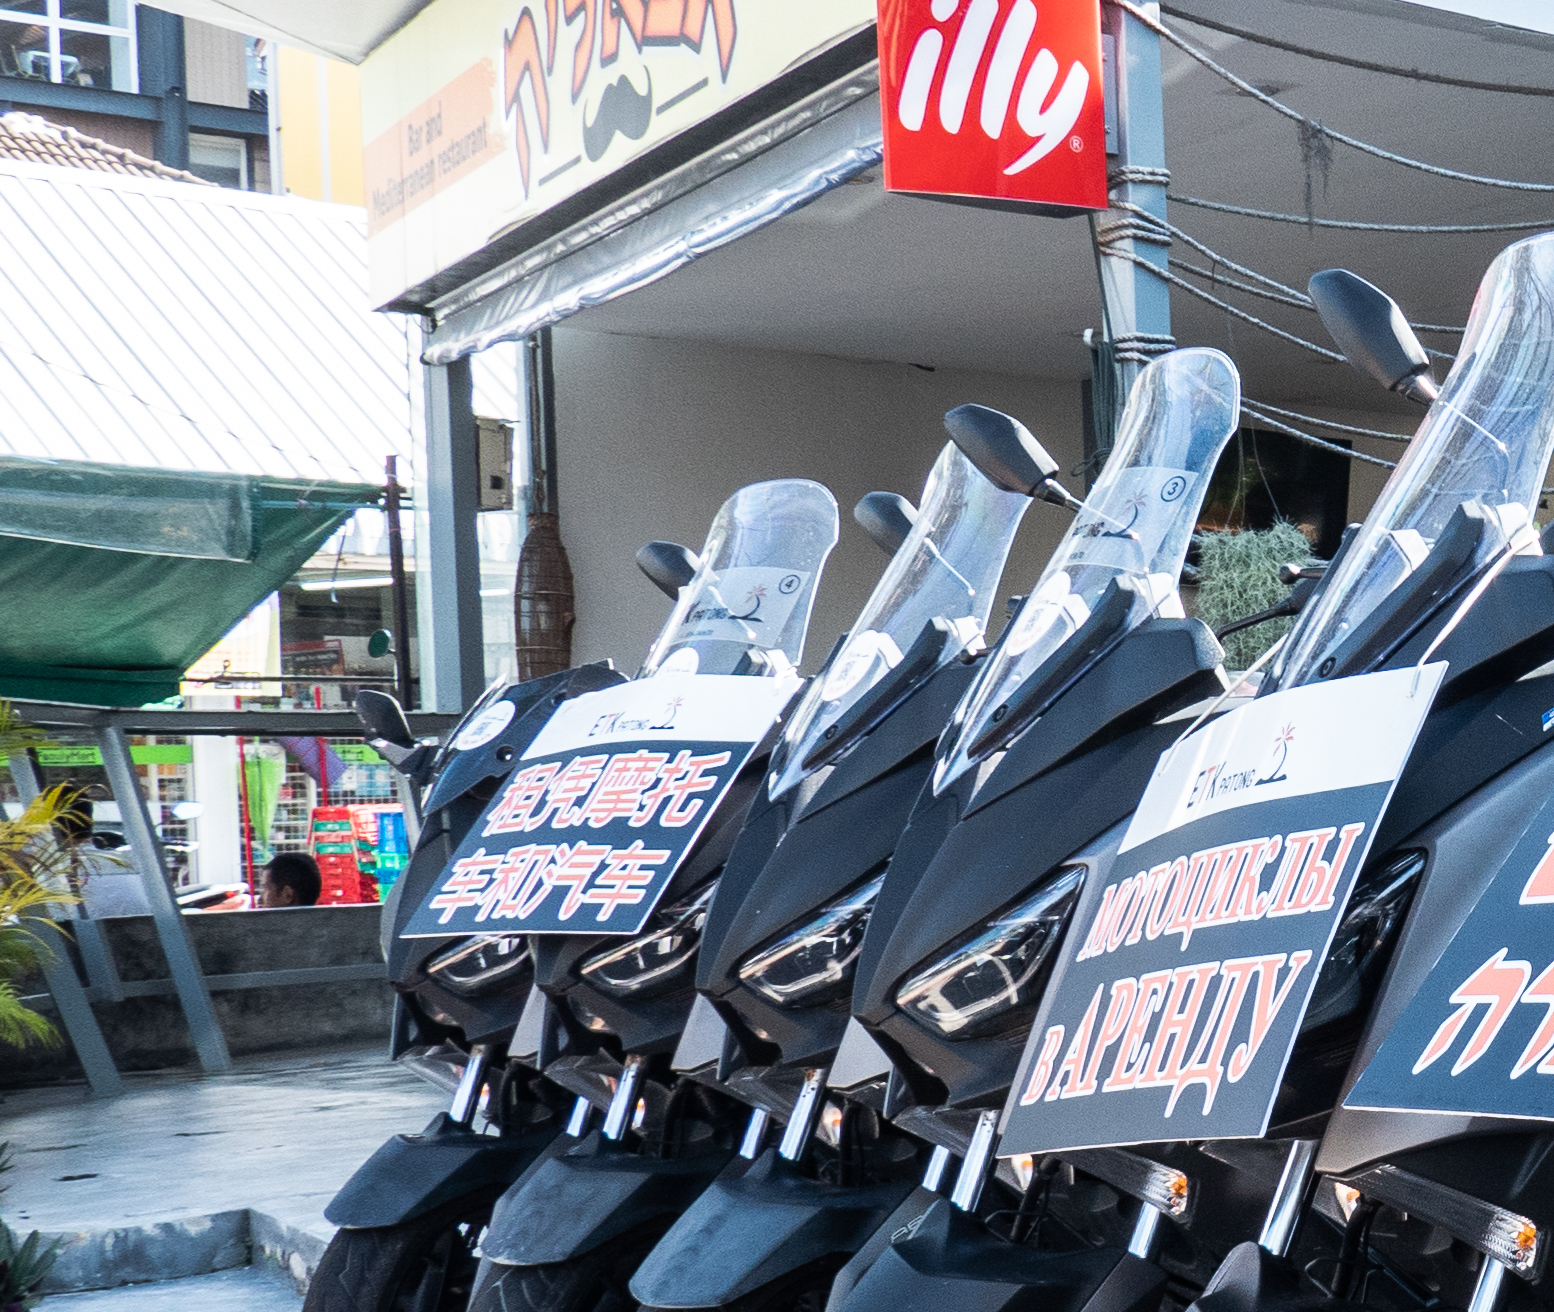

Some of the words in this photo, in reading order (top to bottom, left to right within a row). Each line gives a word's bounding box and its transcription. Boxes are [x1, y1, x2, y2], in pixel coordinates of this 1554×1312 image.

[425, 99, 442, 145] and
[898, 0, 1090, 176] illy
[437, 115, 488, 178] restaurant
[587, 711, 626, 737] ETK
[1186, 761, 1227, 808] ETK
[1217, 769, 1255, 797] PATONG
[429, 839, 671, 924] 车和汽车
[1076, 822, 1365, 963] МОТОЦИКЛЫ
[1045, 950, 1312, 1118] АРЕНДУ
